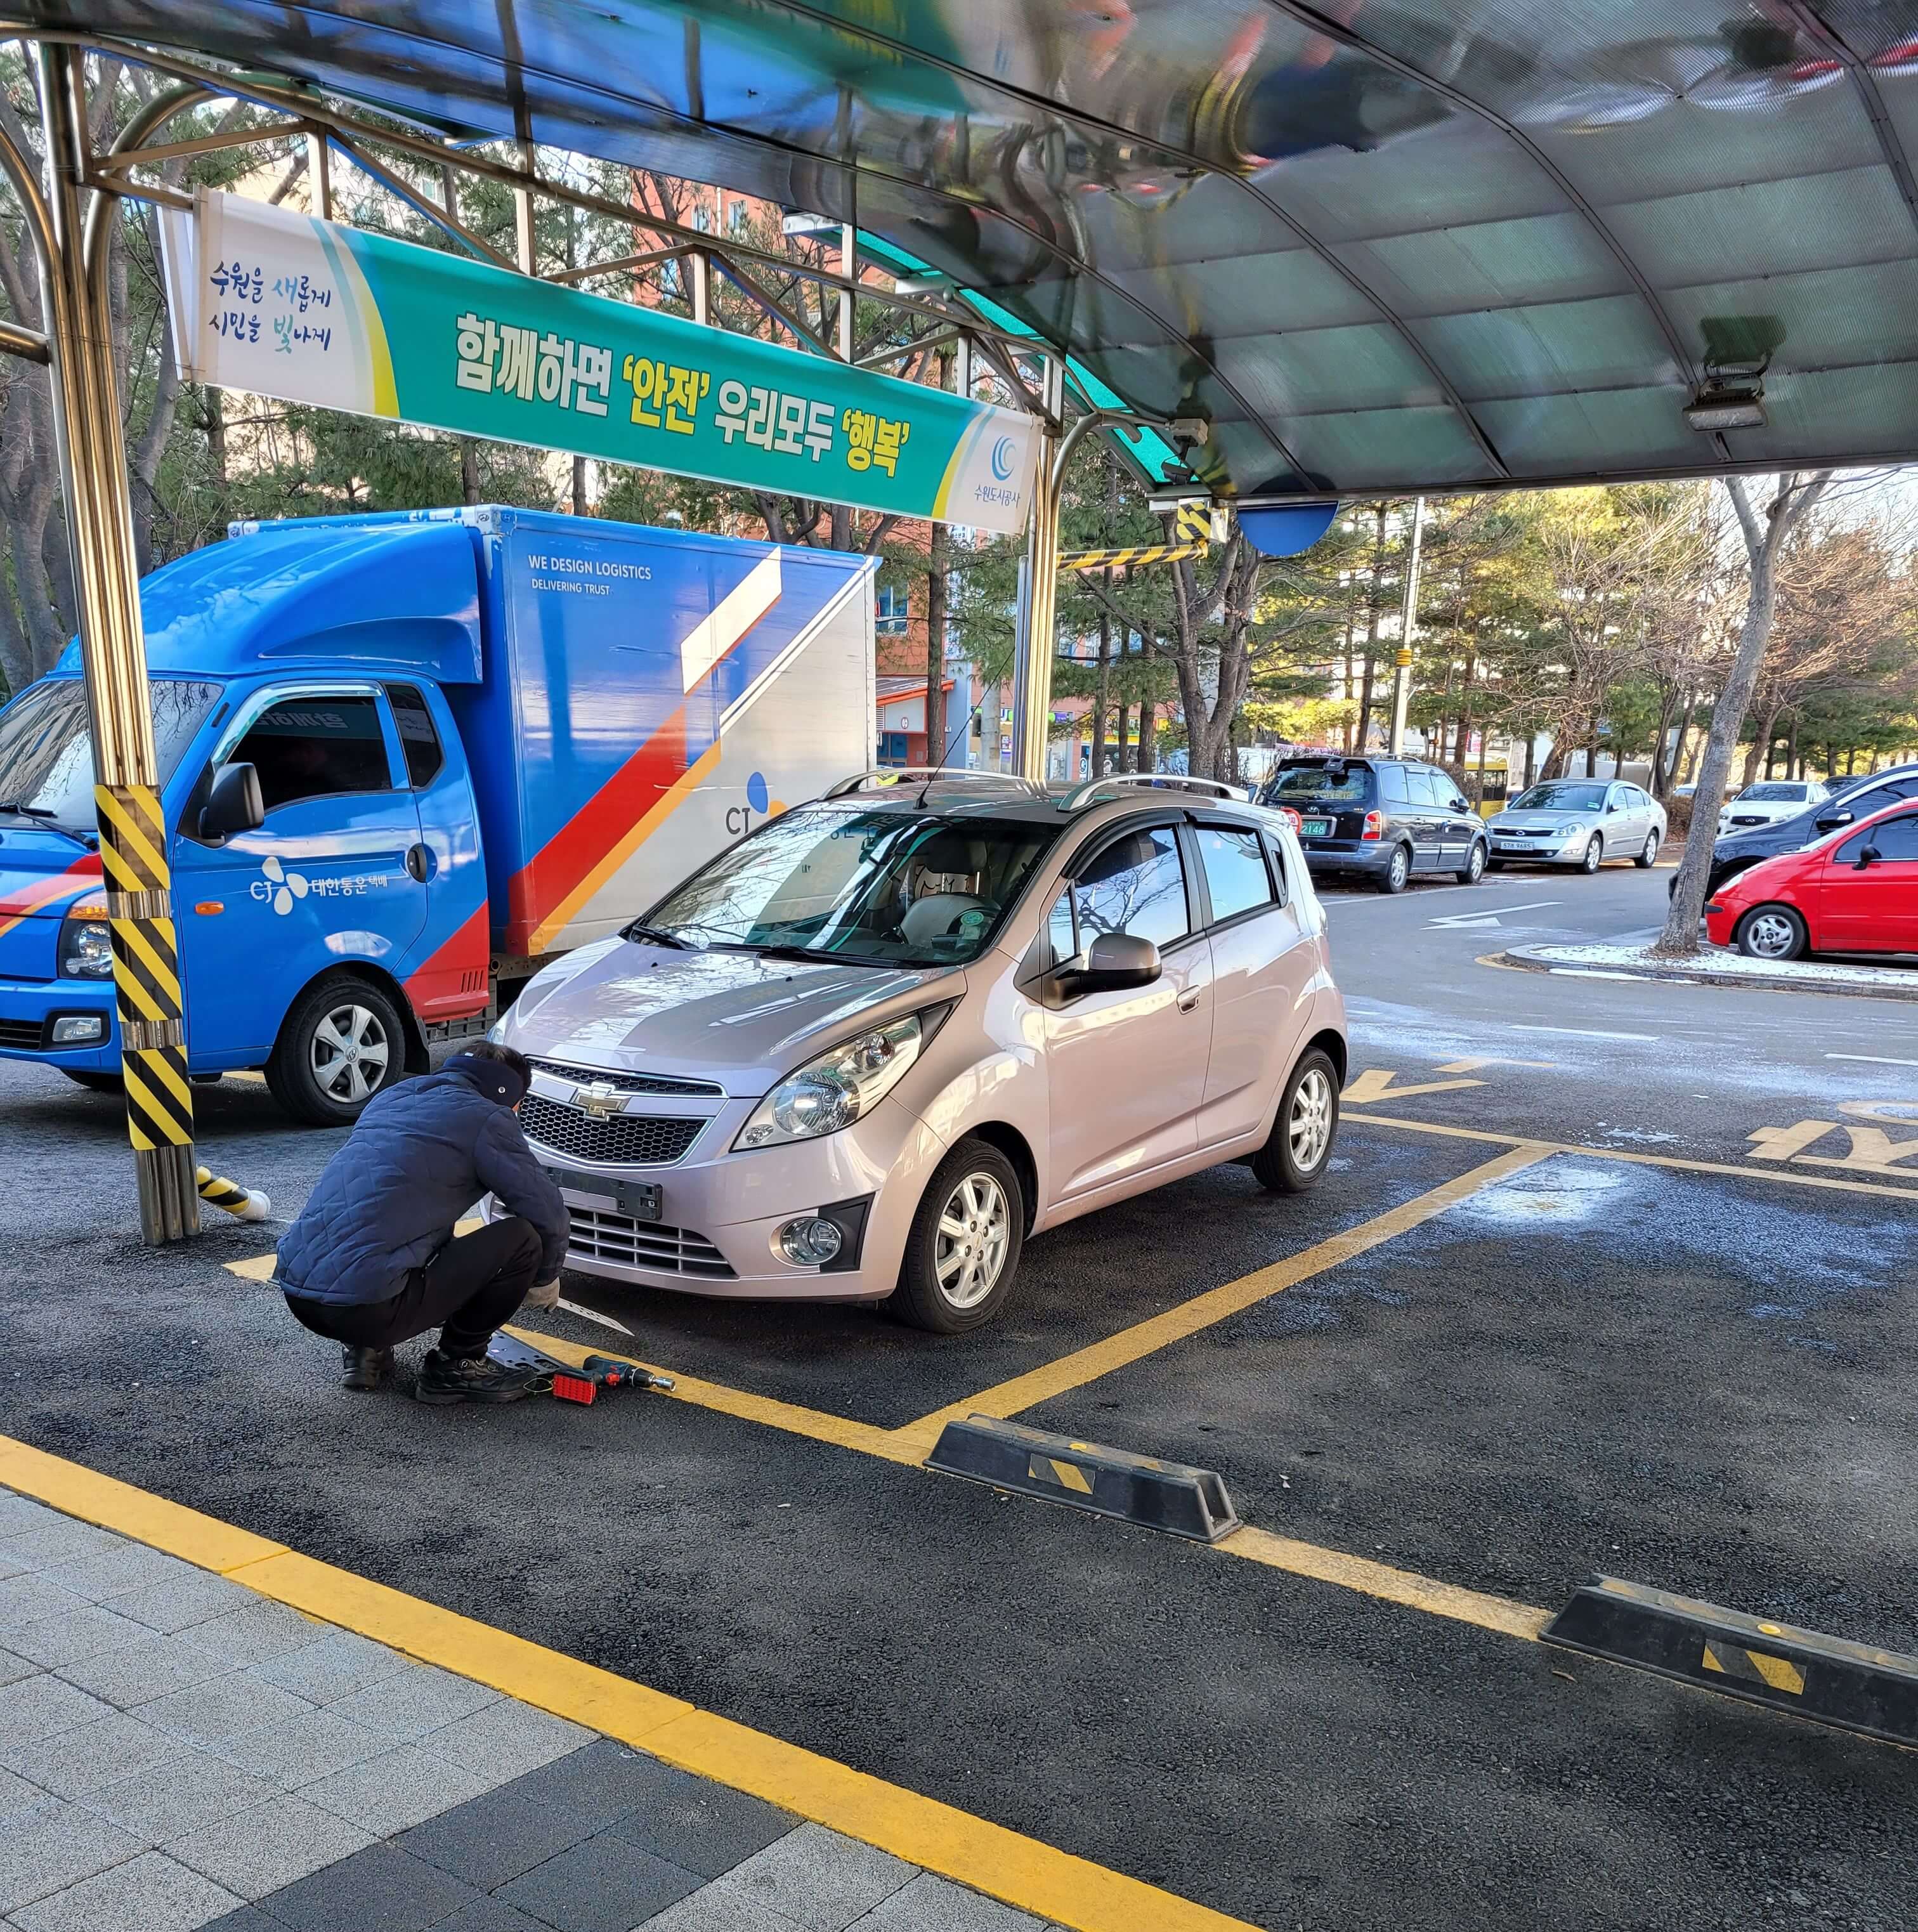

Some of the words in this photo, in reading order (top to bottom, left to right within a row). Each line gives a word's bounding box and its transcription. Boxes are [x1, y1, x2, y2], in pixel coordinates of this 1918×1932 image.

[211, 261, 263, 303] 수원을
[271, 275, 330, 312] 새롭게
[209, 311, 261, 343] 시민을
[274, 315, 330, 354] 빛나게
[456, 311, 612, 417] 함께하면
[714, 380, 835, 462] 우리모두
[974, 484, 1021, 507] 수원도시공사
[528, 555, 547, 570] WE
[551, 557, 592, 574] DESIGN
[596, 561, 651, 580] LOGISTICS
[532, 578, 582, 593] DELIVERING
[584, 584, 610, 595] TRUST
[1302, 825, 1324, 833] 2148
[250, 881, 272, 903] CJ
[311, 878, 367, 896] 대한통운
[369, 875, 388, 887] 택배
